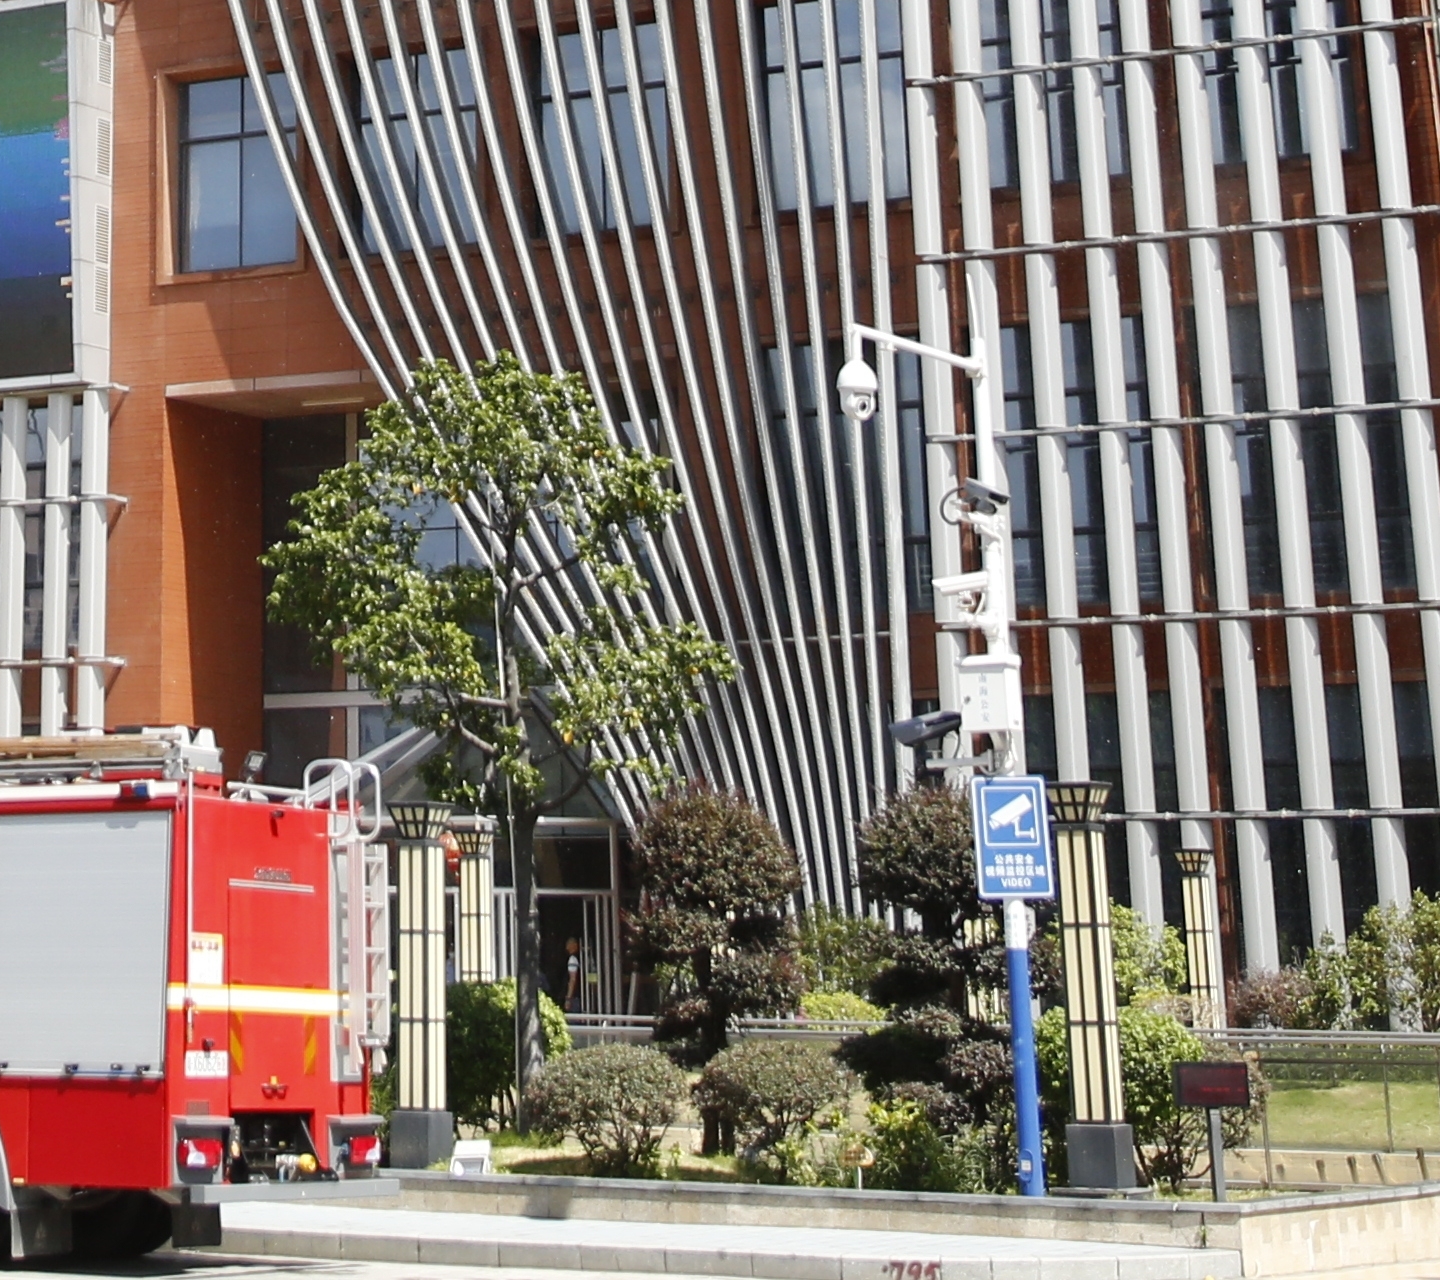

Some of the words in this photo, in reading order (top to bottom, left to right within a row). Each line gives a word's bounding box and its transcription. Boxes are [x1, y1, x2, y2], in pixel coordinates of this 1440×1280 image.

[994, 854, 1034, 865] 公共安全
[1001, 878, 1031, 889] VIDEO
